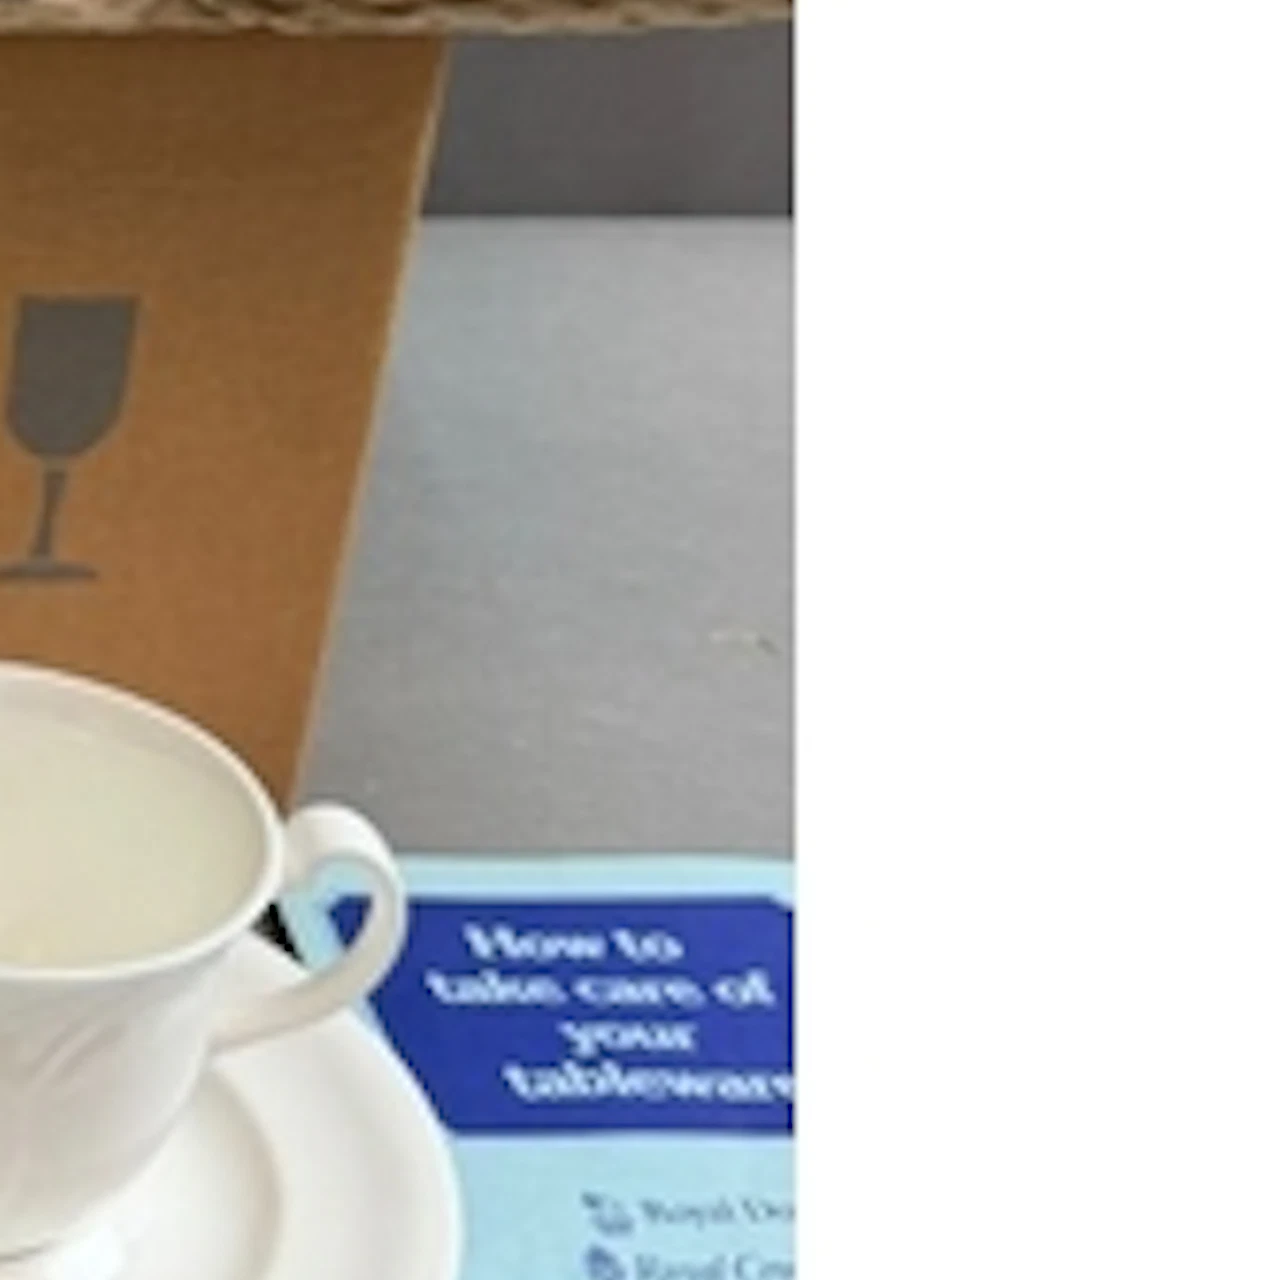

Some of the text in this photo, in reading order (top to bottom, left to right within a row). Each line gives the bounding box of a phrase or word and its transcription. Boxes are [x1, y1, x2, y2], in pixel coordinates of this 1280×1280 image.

[462, 923, 686, 963] How to
[423, 968, 777, 1007] take care of
[556, 1021, 698, 1058] your
[500, 1060, 794, 1102] tablewar
